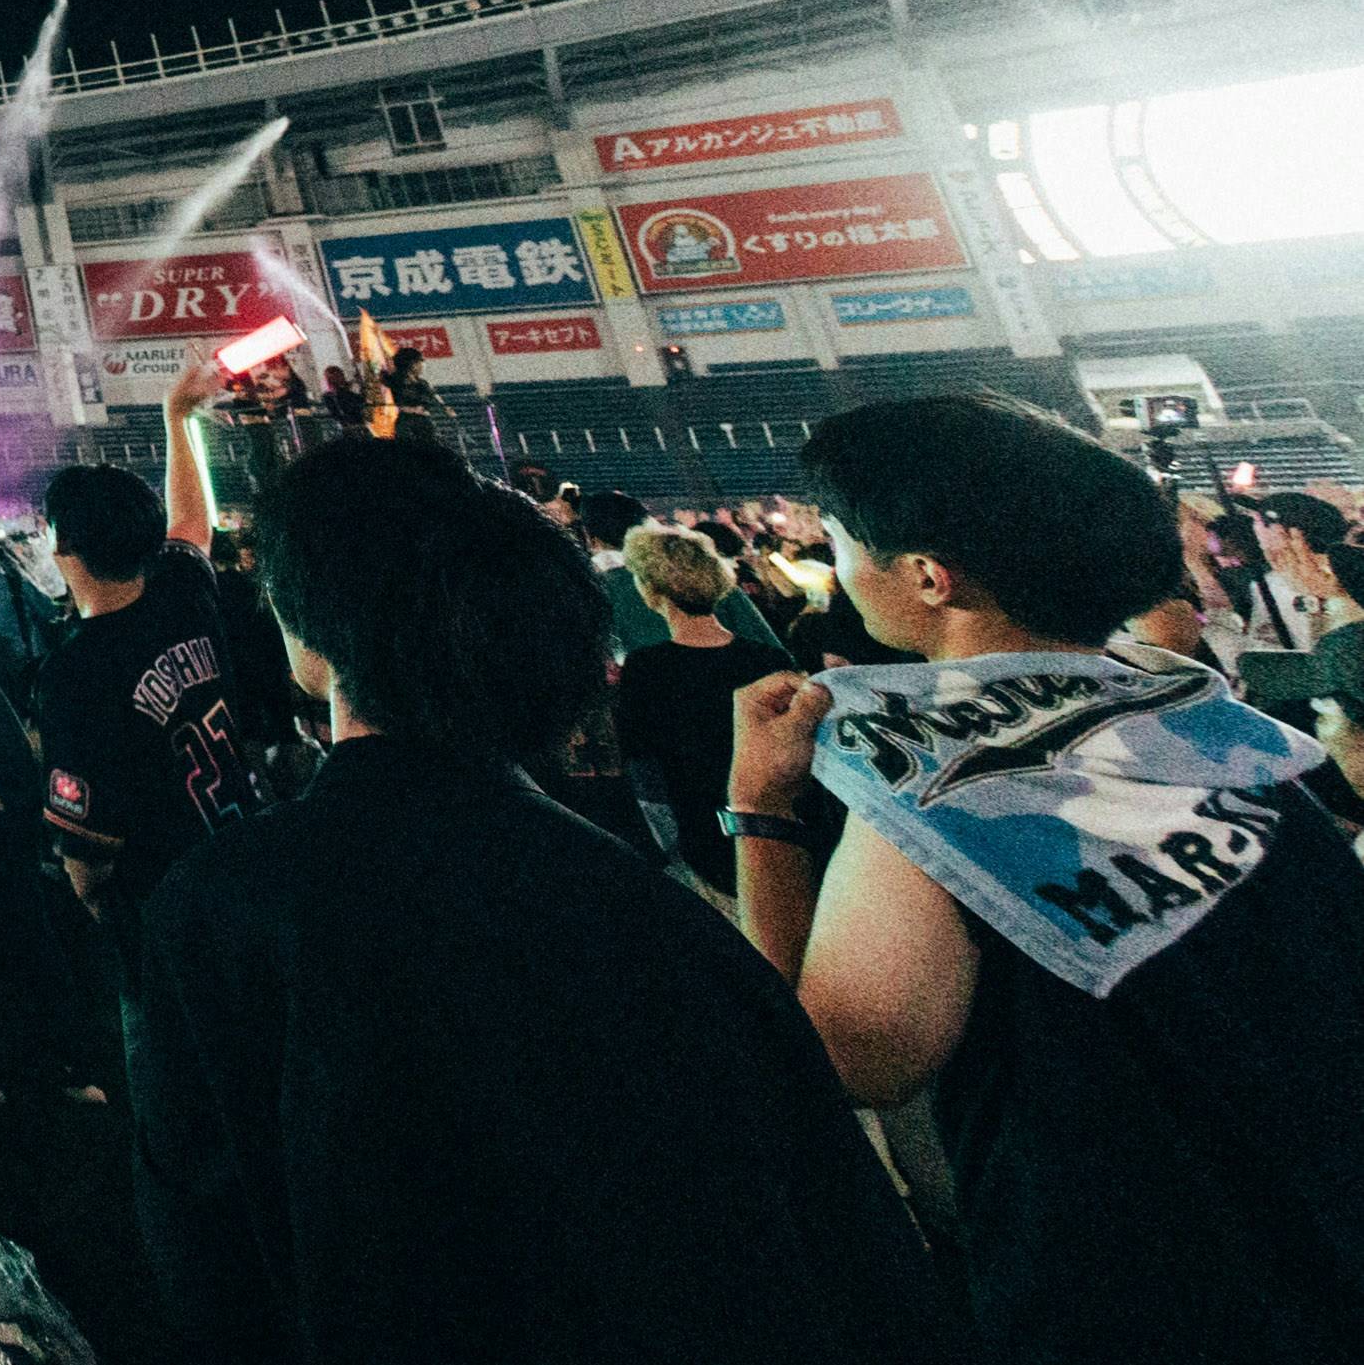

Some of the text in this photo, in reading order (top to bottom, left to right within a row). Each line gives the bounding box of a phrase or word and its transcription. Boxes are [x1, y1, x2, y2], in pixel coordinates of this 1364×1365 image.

[153, 265, 226, 284] SUPER
[331, 238, 587, 301] 京成電鉄
[493, 322, 595, 350] アーキセプト
[131, 360, 181, 375] Group
[132, 635, 221, 728] YOSHII
